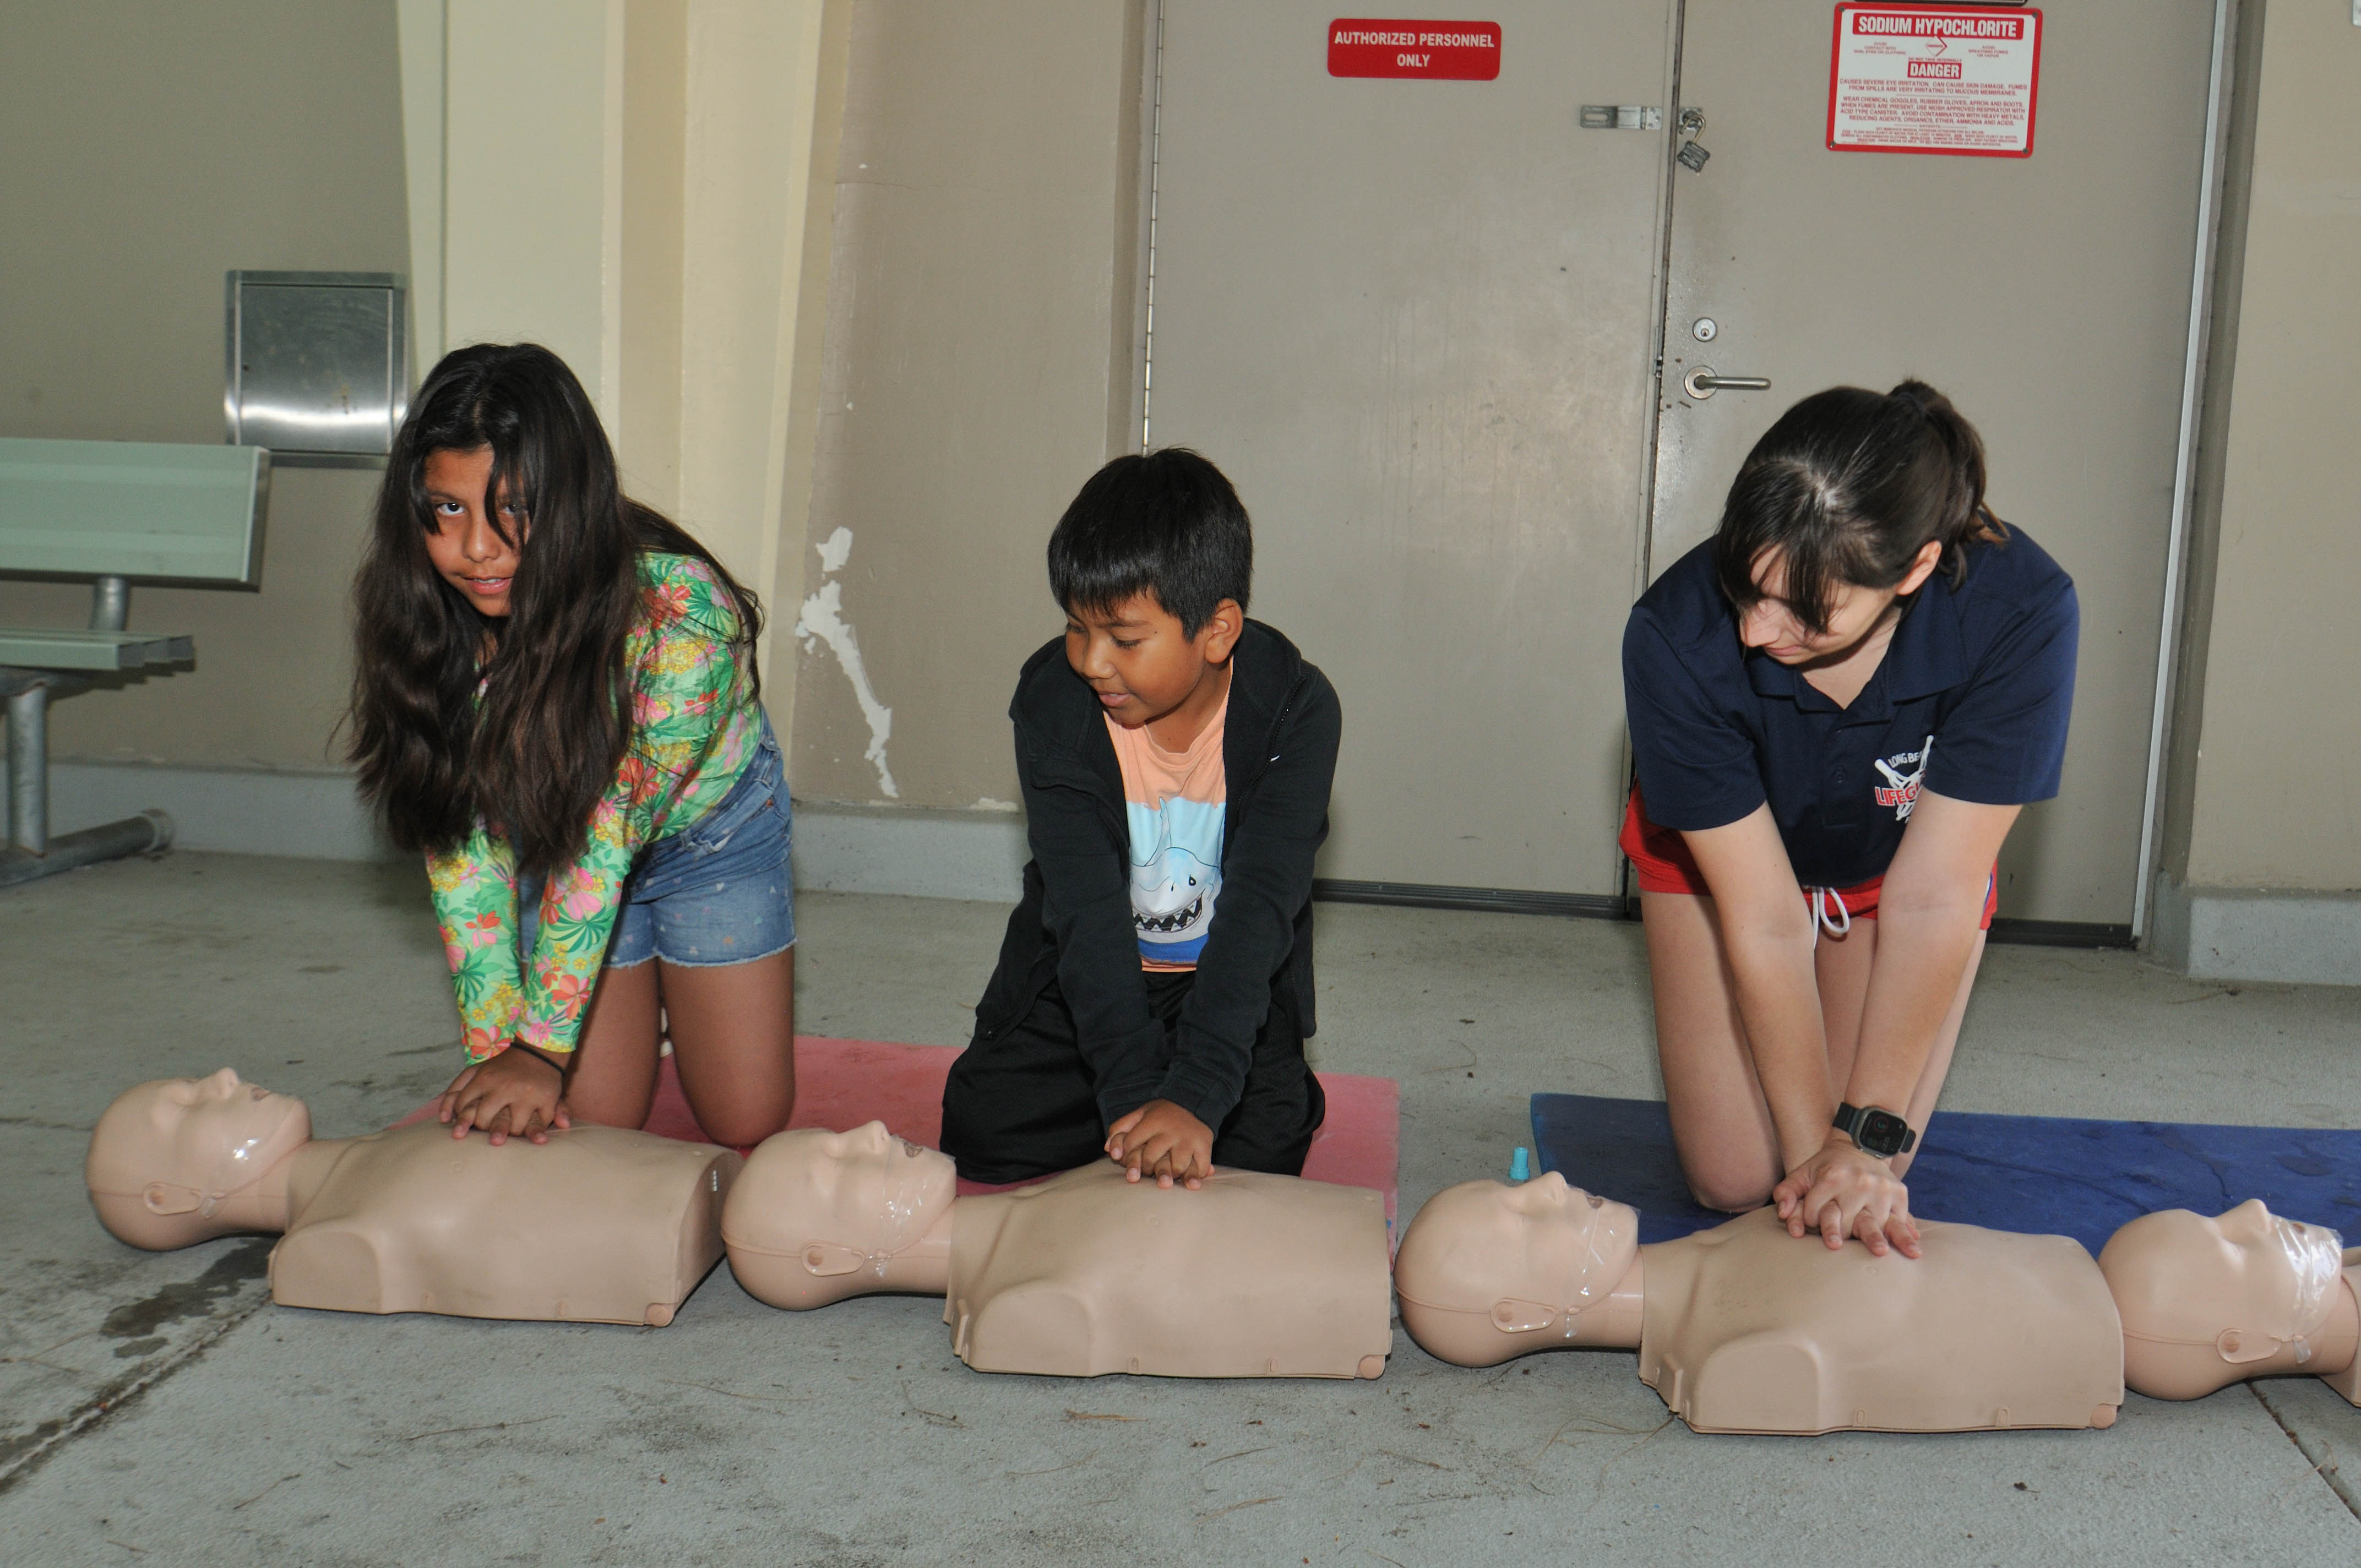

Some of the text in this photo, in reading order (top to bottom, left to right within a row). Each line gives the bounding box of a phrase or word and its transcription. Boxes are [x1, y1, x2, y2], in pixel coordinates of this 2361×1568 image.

[1858, 15, 2017, 37] SODIUM HYPOCHLORITE
[1334, 31, 1494, 48] AUTHORIZED PERSONNEL
[1397, 54, 1430, 67] ONLY
[1910, 63, 1960, 78] DANGER
[1887, 752, 1908, 768] LONG
